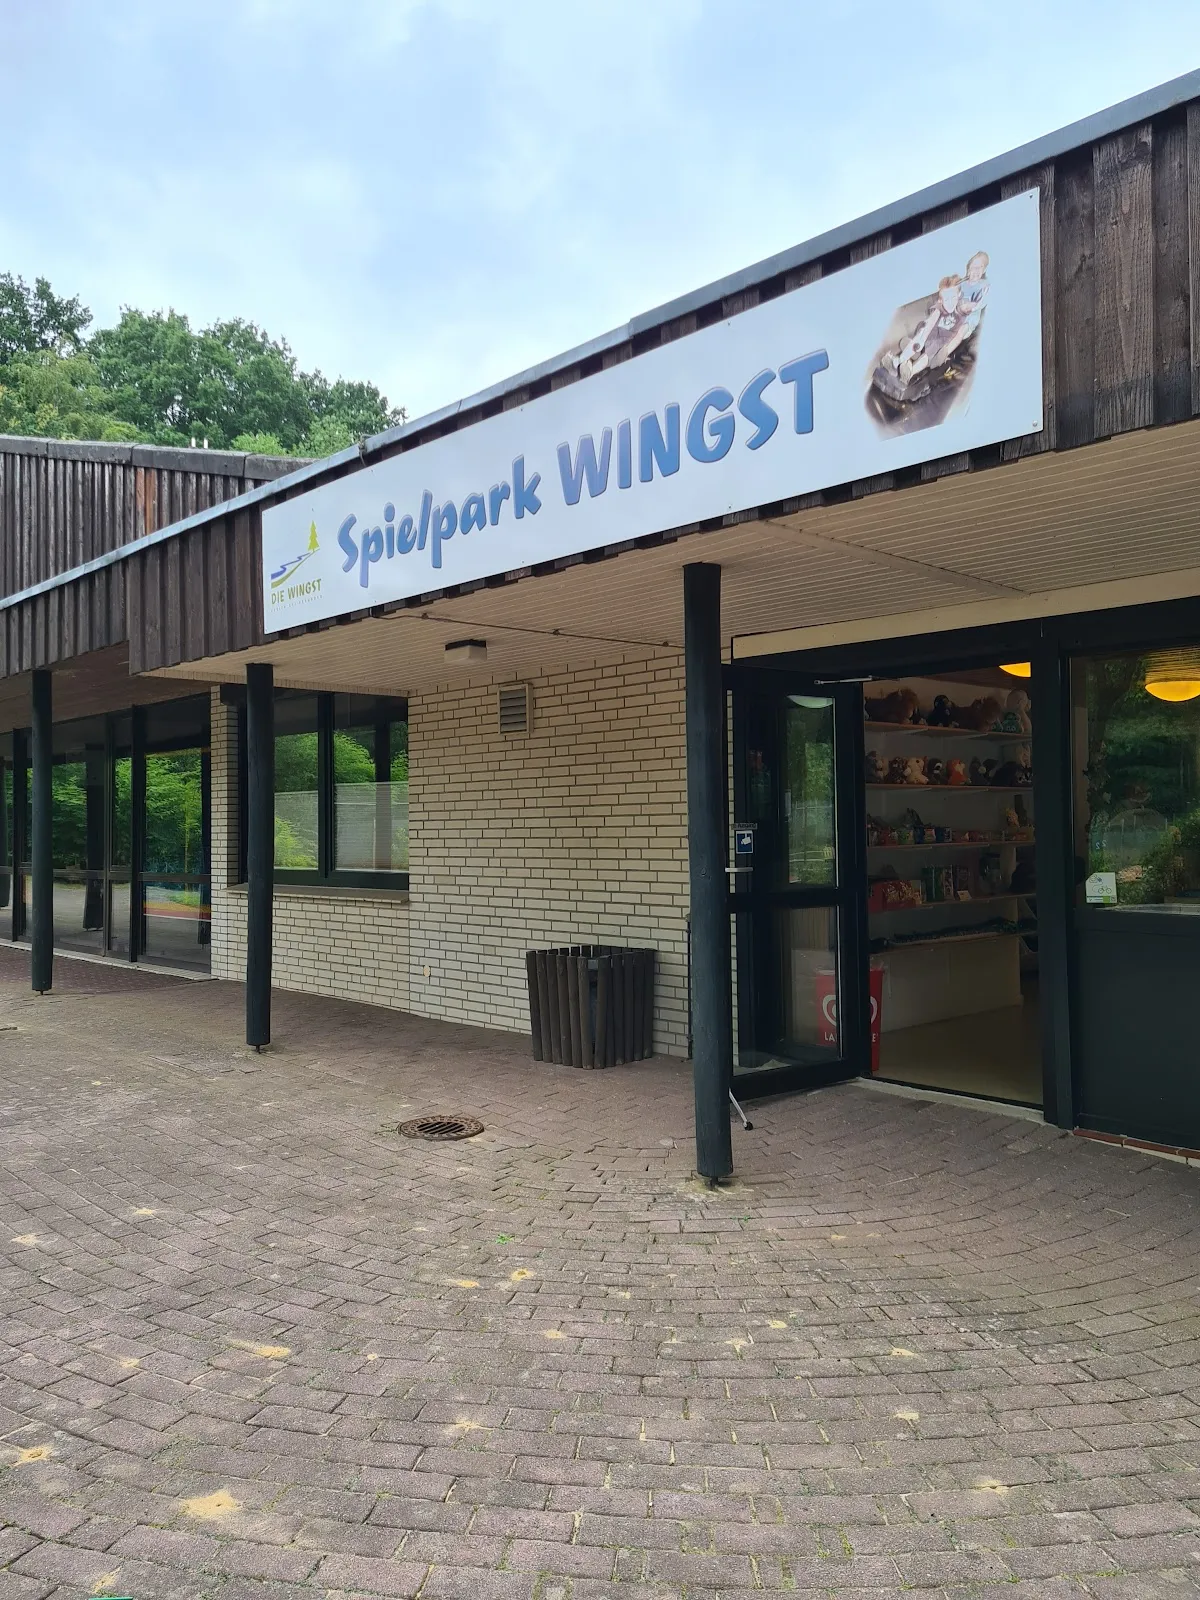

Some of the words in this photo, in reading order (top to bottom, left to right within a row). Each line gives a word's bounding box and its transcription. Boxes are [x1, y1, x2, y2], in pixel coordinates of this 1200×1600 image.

[337, 454, 542, 588] Spielpark
[556, 348, 830, 506] WINGST
[271, 590, 285, 605] DIE
[287, 578, 322, 600] WINGST
